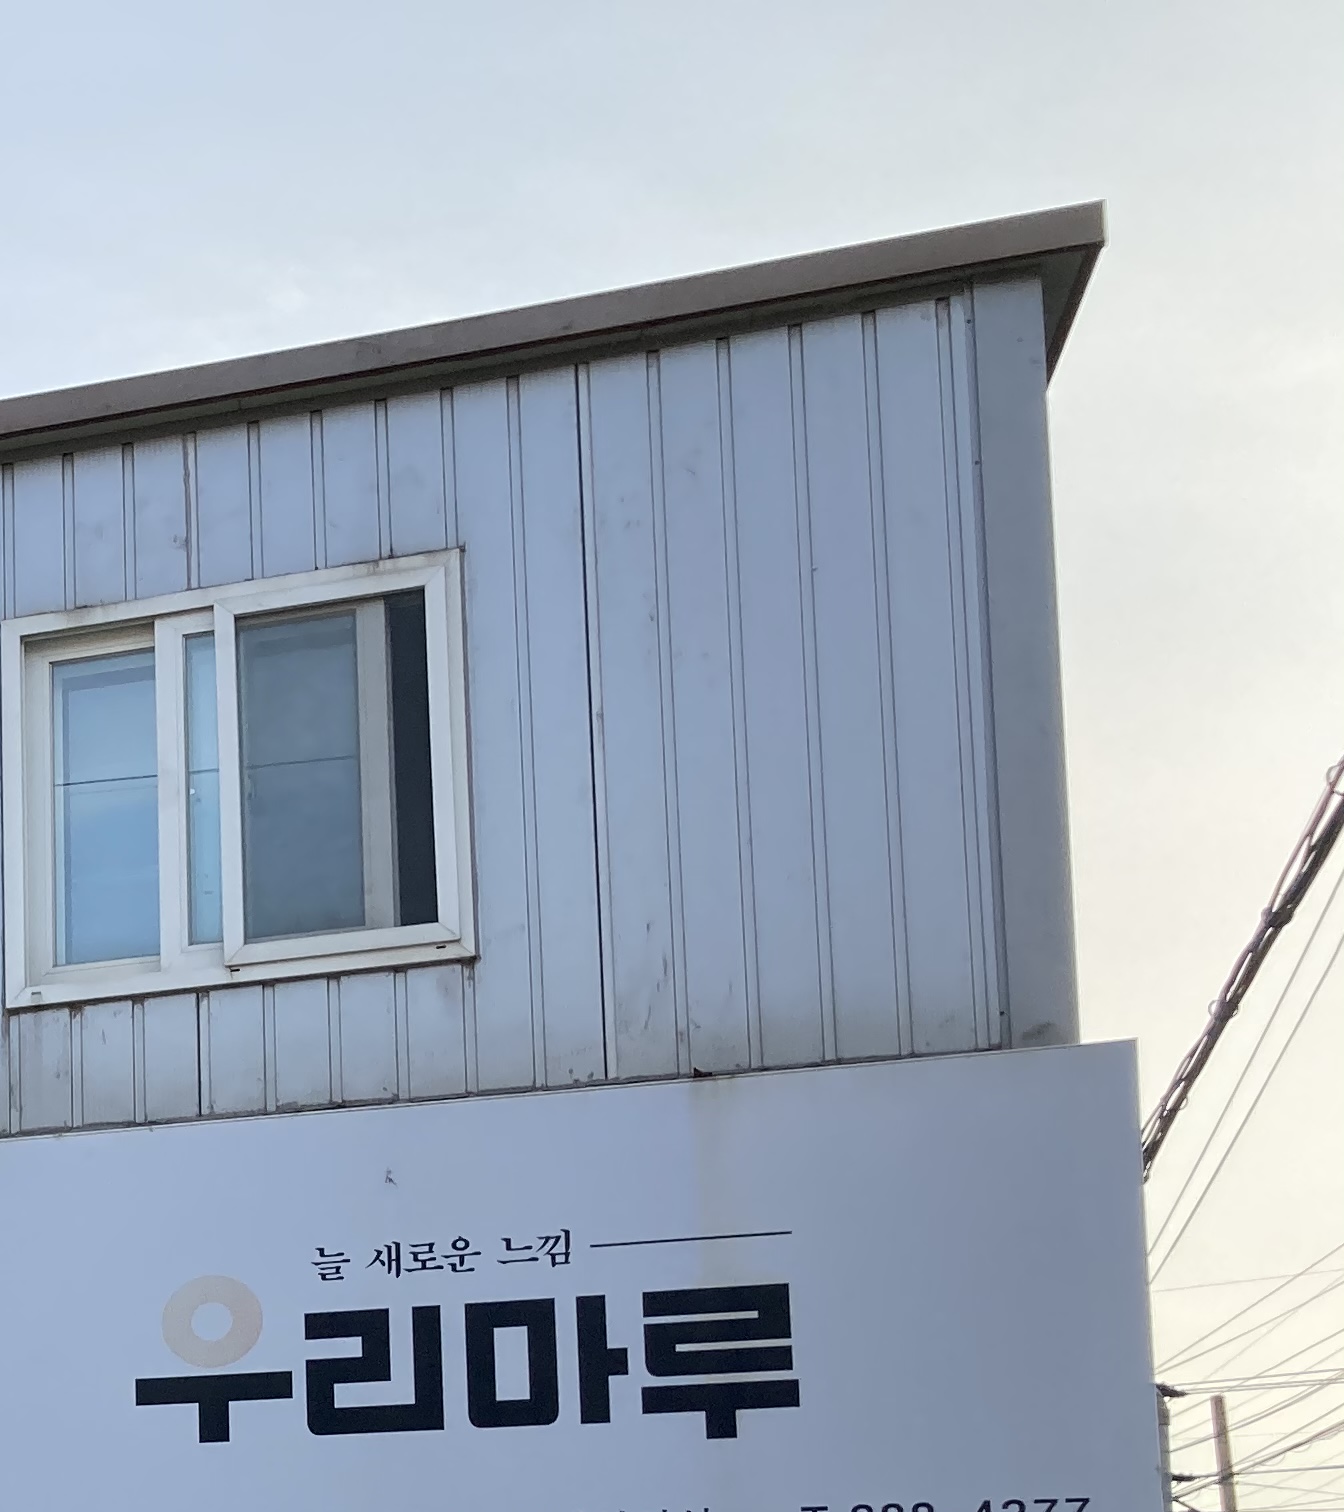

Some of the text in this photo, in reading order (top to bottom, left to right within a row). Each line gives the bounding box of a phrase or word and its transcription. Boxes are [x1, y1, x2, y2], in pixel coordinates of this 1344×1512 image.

[311, 1228, 571, 1281] 늘 새로운 느낌
[135, 1273, 801, 1443] 우리마루
